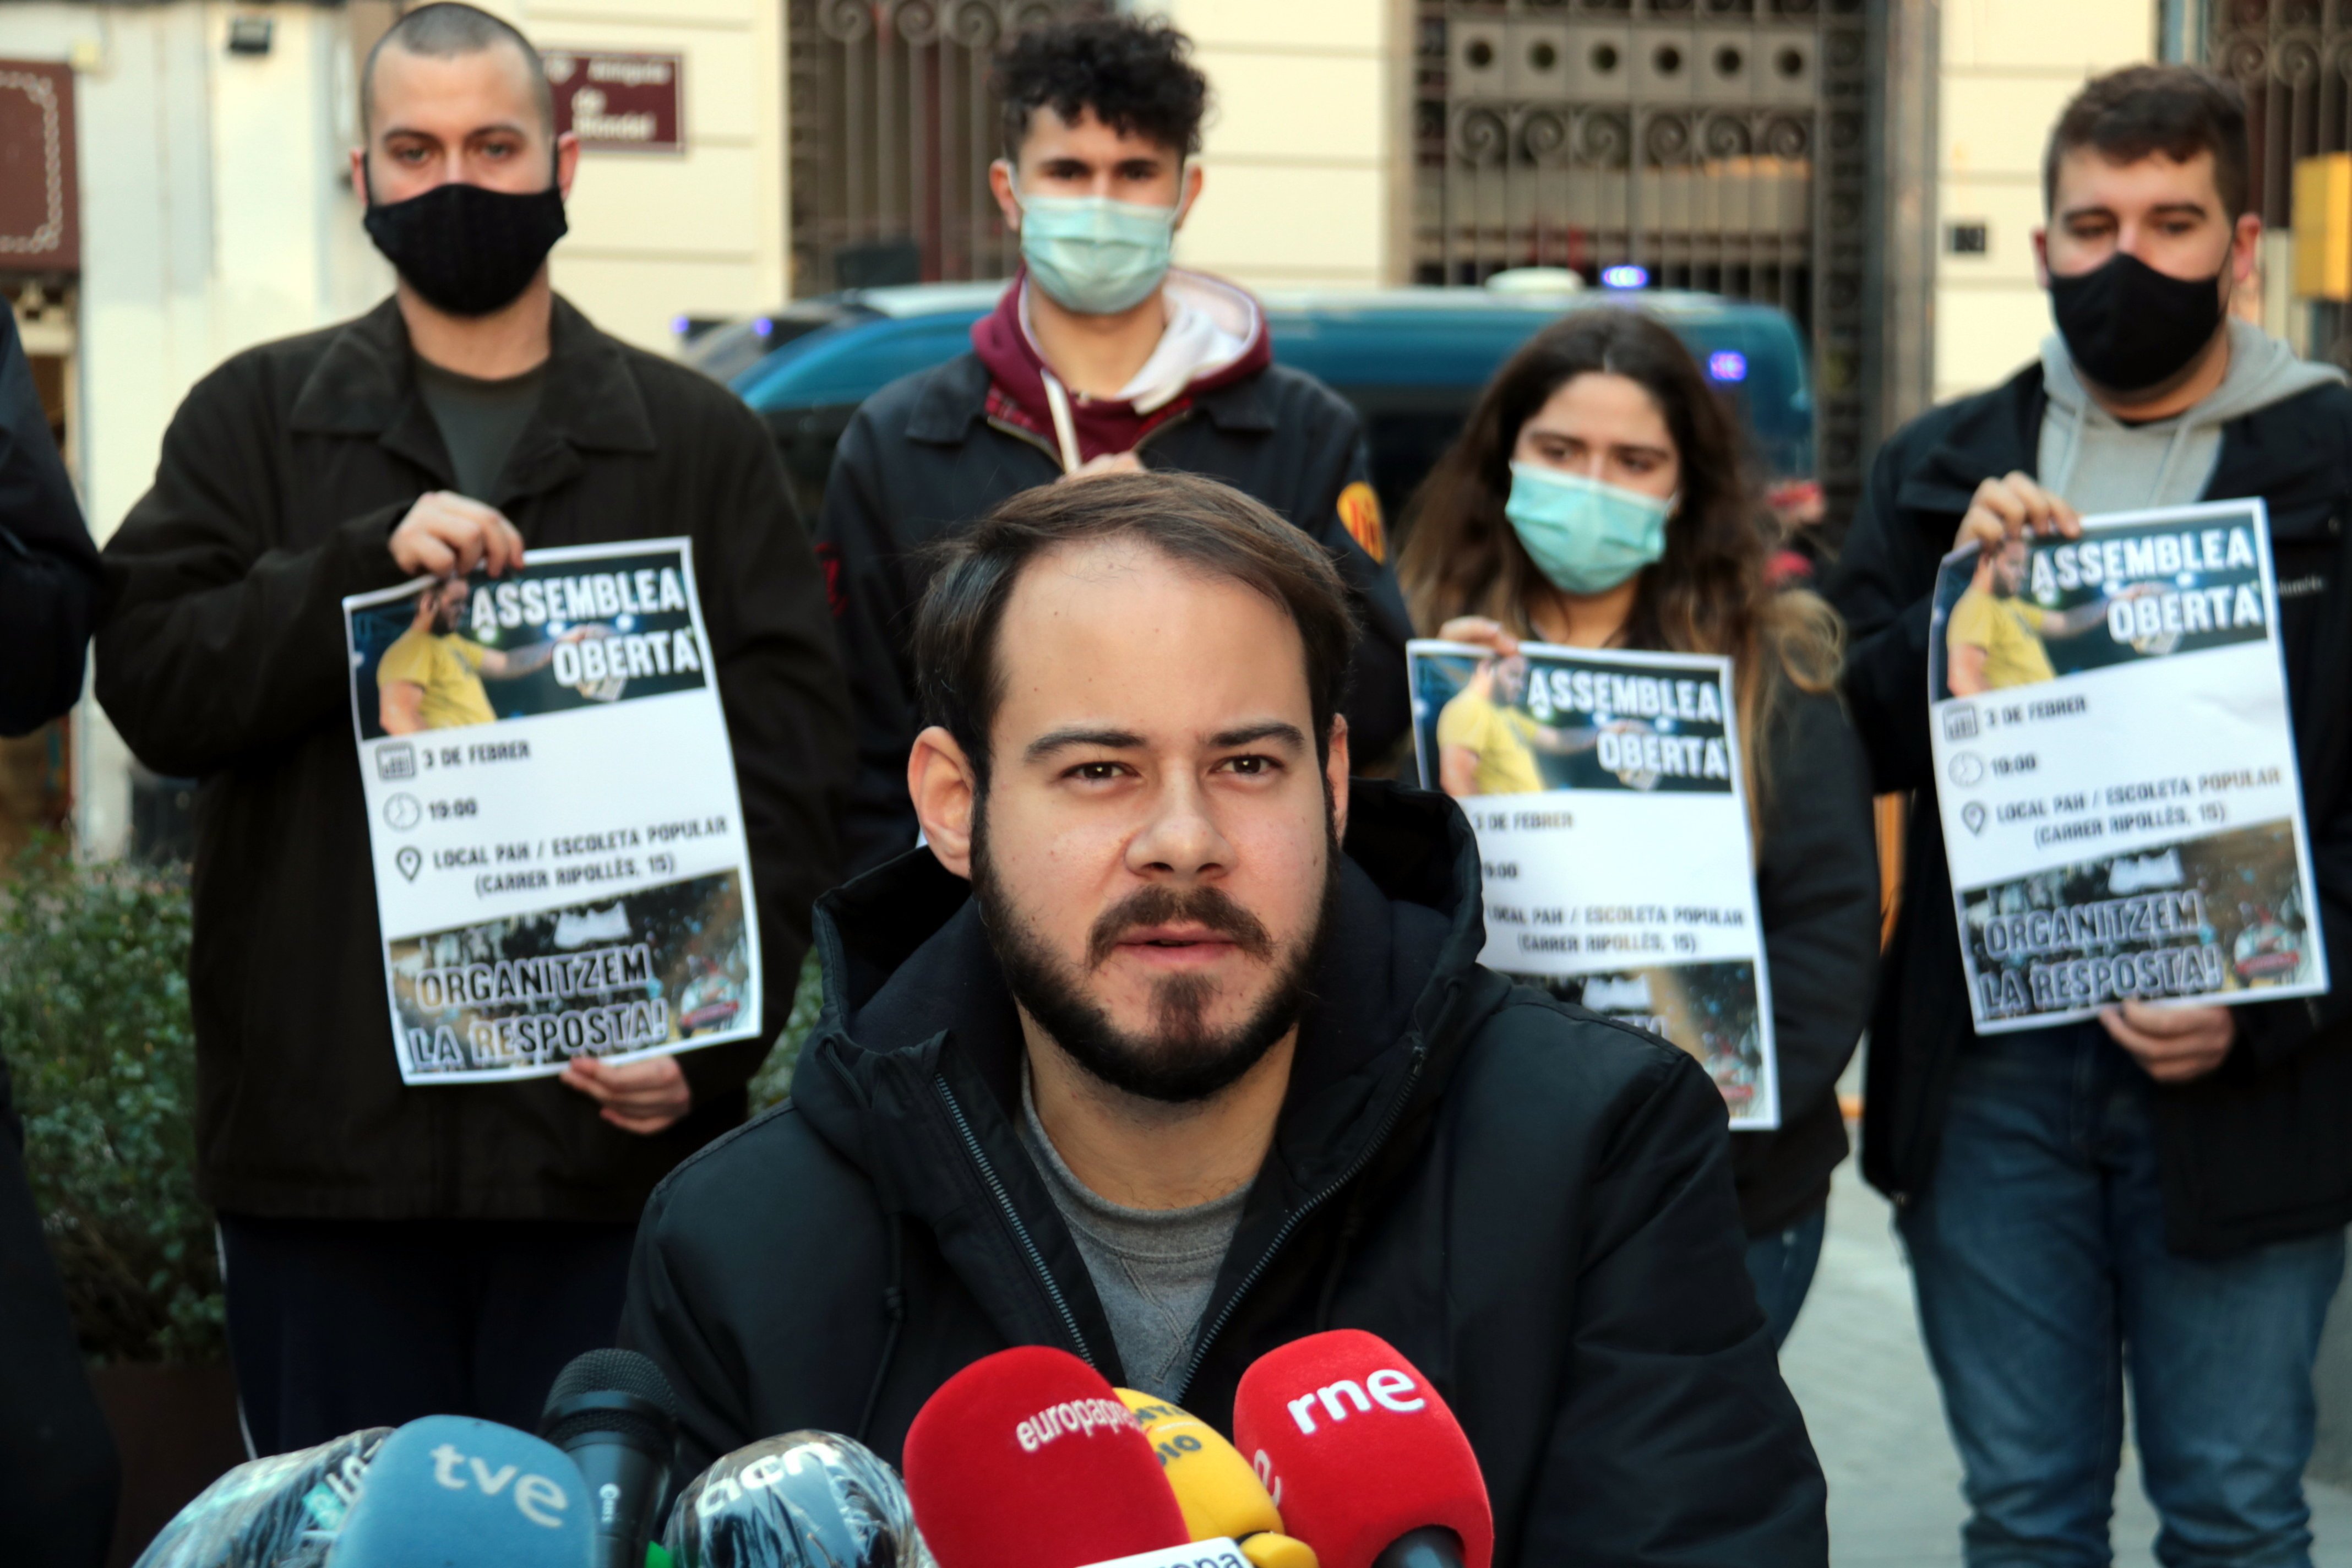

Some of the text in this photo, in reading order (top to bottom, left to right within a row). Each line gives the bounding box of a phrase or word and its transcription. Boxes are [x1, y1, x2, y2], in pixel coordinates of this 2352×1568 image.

[2031, 527, 2255, 594] ASSEMBLEA
[471, 567, 688, 629] ASSEMBLEA
[2107, 584, 2263, 644] OBERTA
[552, 629, 700, 687] OBERTA
[1527, 668, 1723, 723] ASSEMBLEA
[2002, 704, 2021, 724] DE
[2028, 694, 2086, 721] FEBRER
[422, 741, 530, 769] 3 DE FEBRER
[1597, 731, 1729, 780] OBERTA
[1489, 812, 1506, 831] DE
[1997, 801, 2046, 823] LOCAL
[2054, 793, 2085, 814] PAH
[2106, 777, 2190, 805] ESCOLETA
[2198, 768, 2281, 792] POPULAR
[433, 846, 487, 869] LOCAL
[496, 841, 529, 863] PAH
[552, 829, 640, 857] ESCOLETA
[647, 816, 728, 841] POPULAR
[1533, 908, 1562, 924] PAH
[1585, 907, 1667, 924] ESCOLETA
[1674, 908, 1743, 926] POPULAR
[1984, 888, 2201, 962] ORGANITZEM
[416, 943, 651, 1011] ORGANITZEM
[1981, 944, 2223, 1016] LA RESPOSTA!
[409, 998, 669, 1069] LA RESPOSTA!
[1287, 1369, 1426, 1434] rne
[429, 1443, 568, 1528] tve
